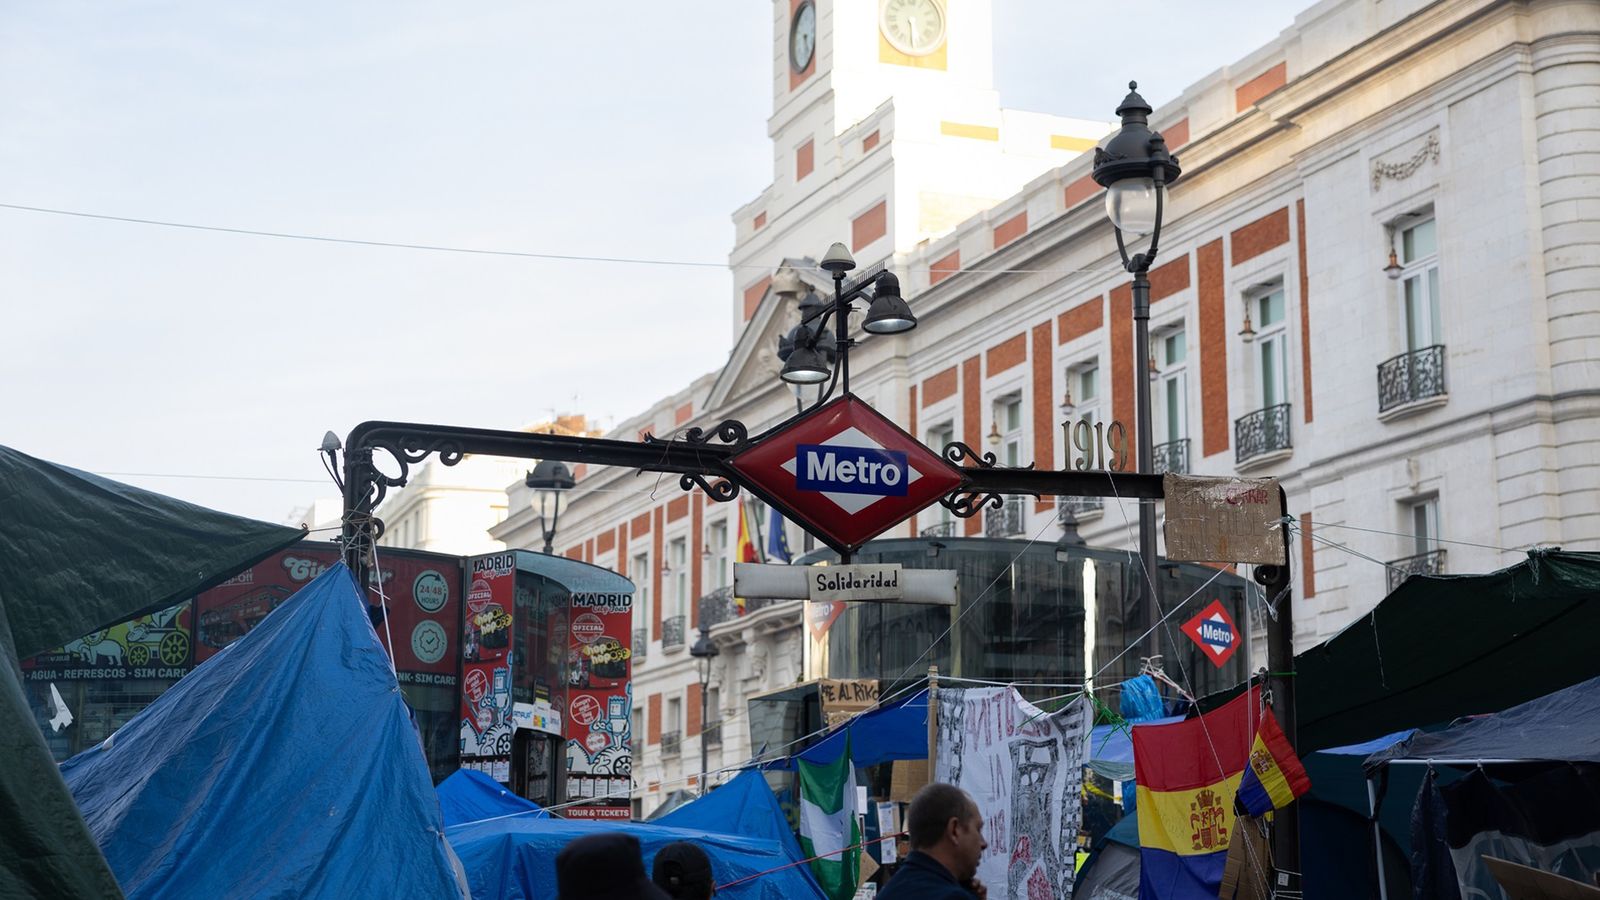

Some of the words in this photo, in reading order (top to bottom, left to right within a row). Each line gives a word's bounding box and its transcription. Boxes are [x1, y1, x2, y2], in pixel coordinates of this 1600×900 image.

[1061, 419, 1128, 472] 1919
[806, 450, 901, 487] Metro
[816, 569, 898, 592] Solidaridad
[573, 594, 632, 607] MADRID
[1203, 623, 1231, 644] Metro
[31, 670, 57, 680] AGUA
[63, 667, 126, 679] REFRESCOS
[134, 668, 156, 679] SIM
[415, 672, 433, 684] SIM
[838, 682, 852, 701] AL
[568, 809, 589, 817] TOUR
[589, 809, 596, 817] &
[596, 809, 630, 817] TICKETS
